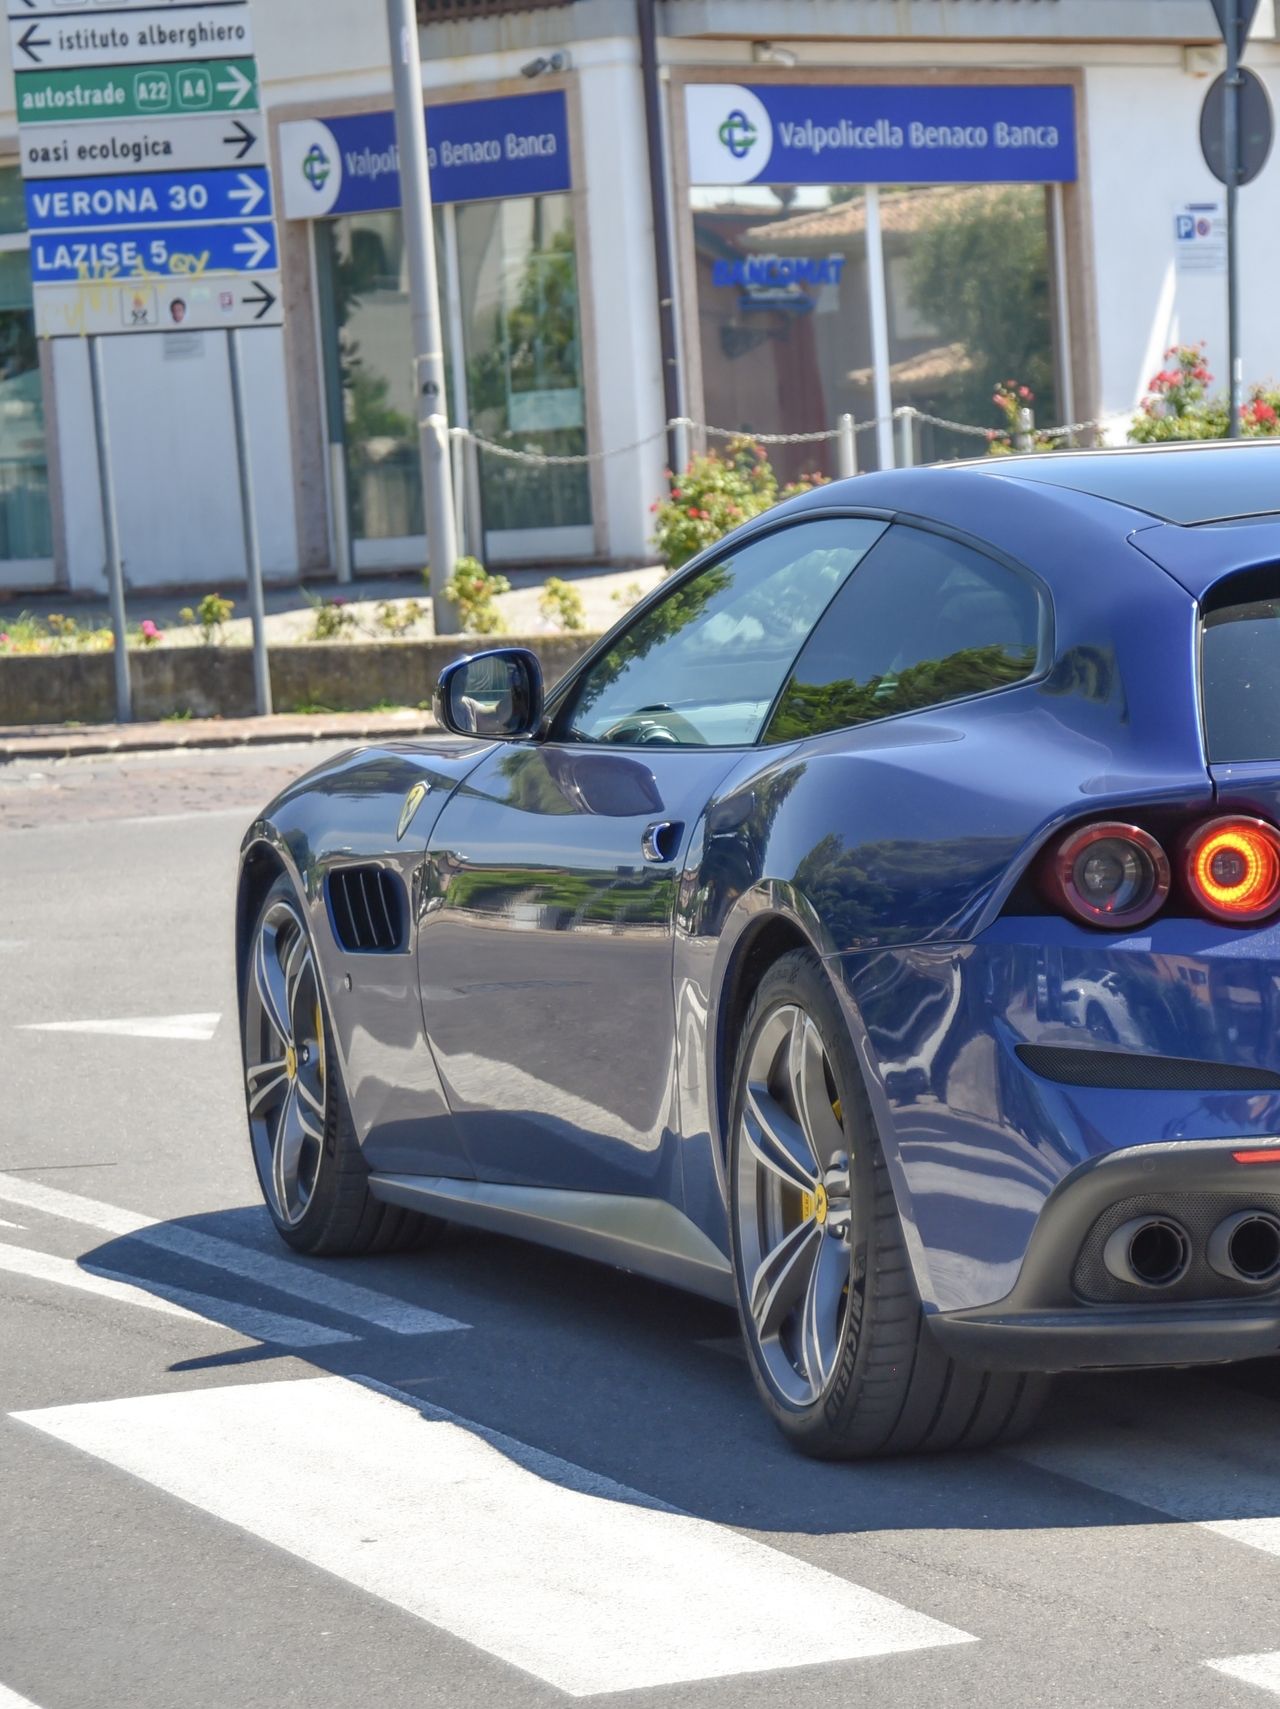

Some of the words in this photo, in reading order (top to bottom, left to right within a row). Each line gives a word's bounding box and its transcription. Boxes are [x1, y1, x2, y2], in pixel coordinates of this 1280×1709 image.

[59, 28, 129, 50] istituto
[138, 21, 245, 48] alberghiero
[22, 81, 125, 109] autostrade
[138, 81, 167, 101] A22
[182, 79, 205, 98] A4
[29, 140, 69, 162] oasi
[77, 135, 172, 162] ecologica
[441, 140, 501, 167] Benaco
[505, 133, 556, 159] Banca
[778, 119, 903, 154] Valpolicella
[909, 121, 988, 148] Benaco
[994, 121, 1059, 148] Banca
[32, 186, 158, 218] VERONA
[168, 184, 208, 211] 30
[36, 242, 137, 270] LAZISE
[151, 240, 167, 265] 5
[713, 257, 846, 288] BANCOMAT
